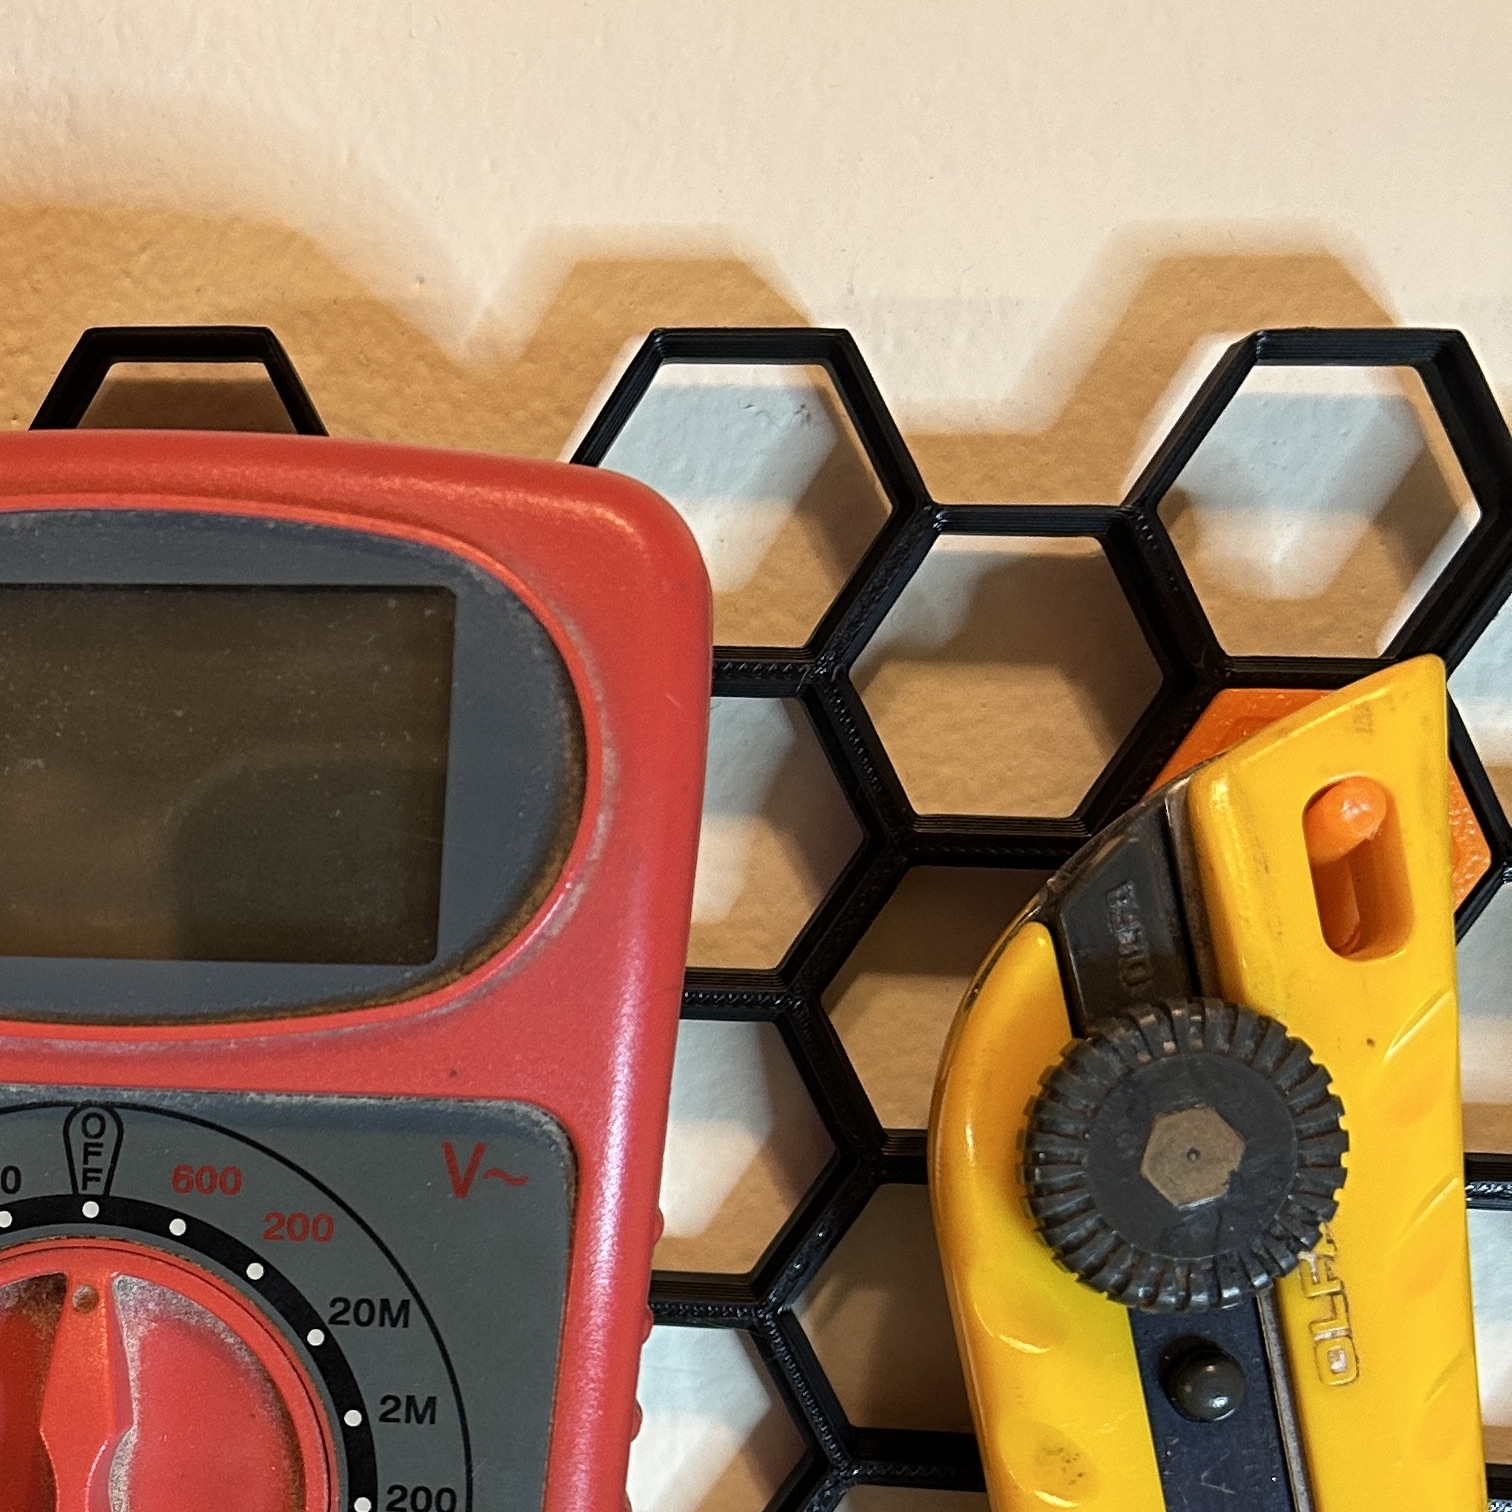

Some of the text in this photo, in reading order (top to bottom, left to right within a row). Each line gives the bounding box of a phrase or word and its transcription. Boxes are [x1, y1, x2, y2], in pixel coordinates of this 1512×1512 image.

[80, 1111, 107, 1193] OFF
[172, 1165, 242, 1195] 600
[263, 1212, 334, 1242] 200
[329, 1297, 411, 1328] 20M
[379, 1395, 436, 1424] 2M
